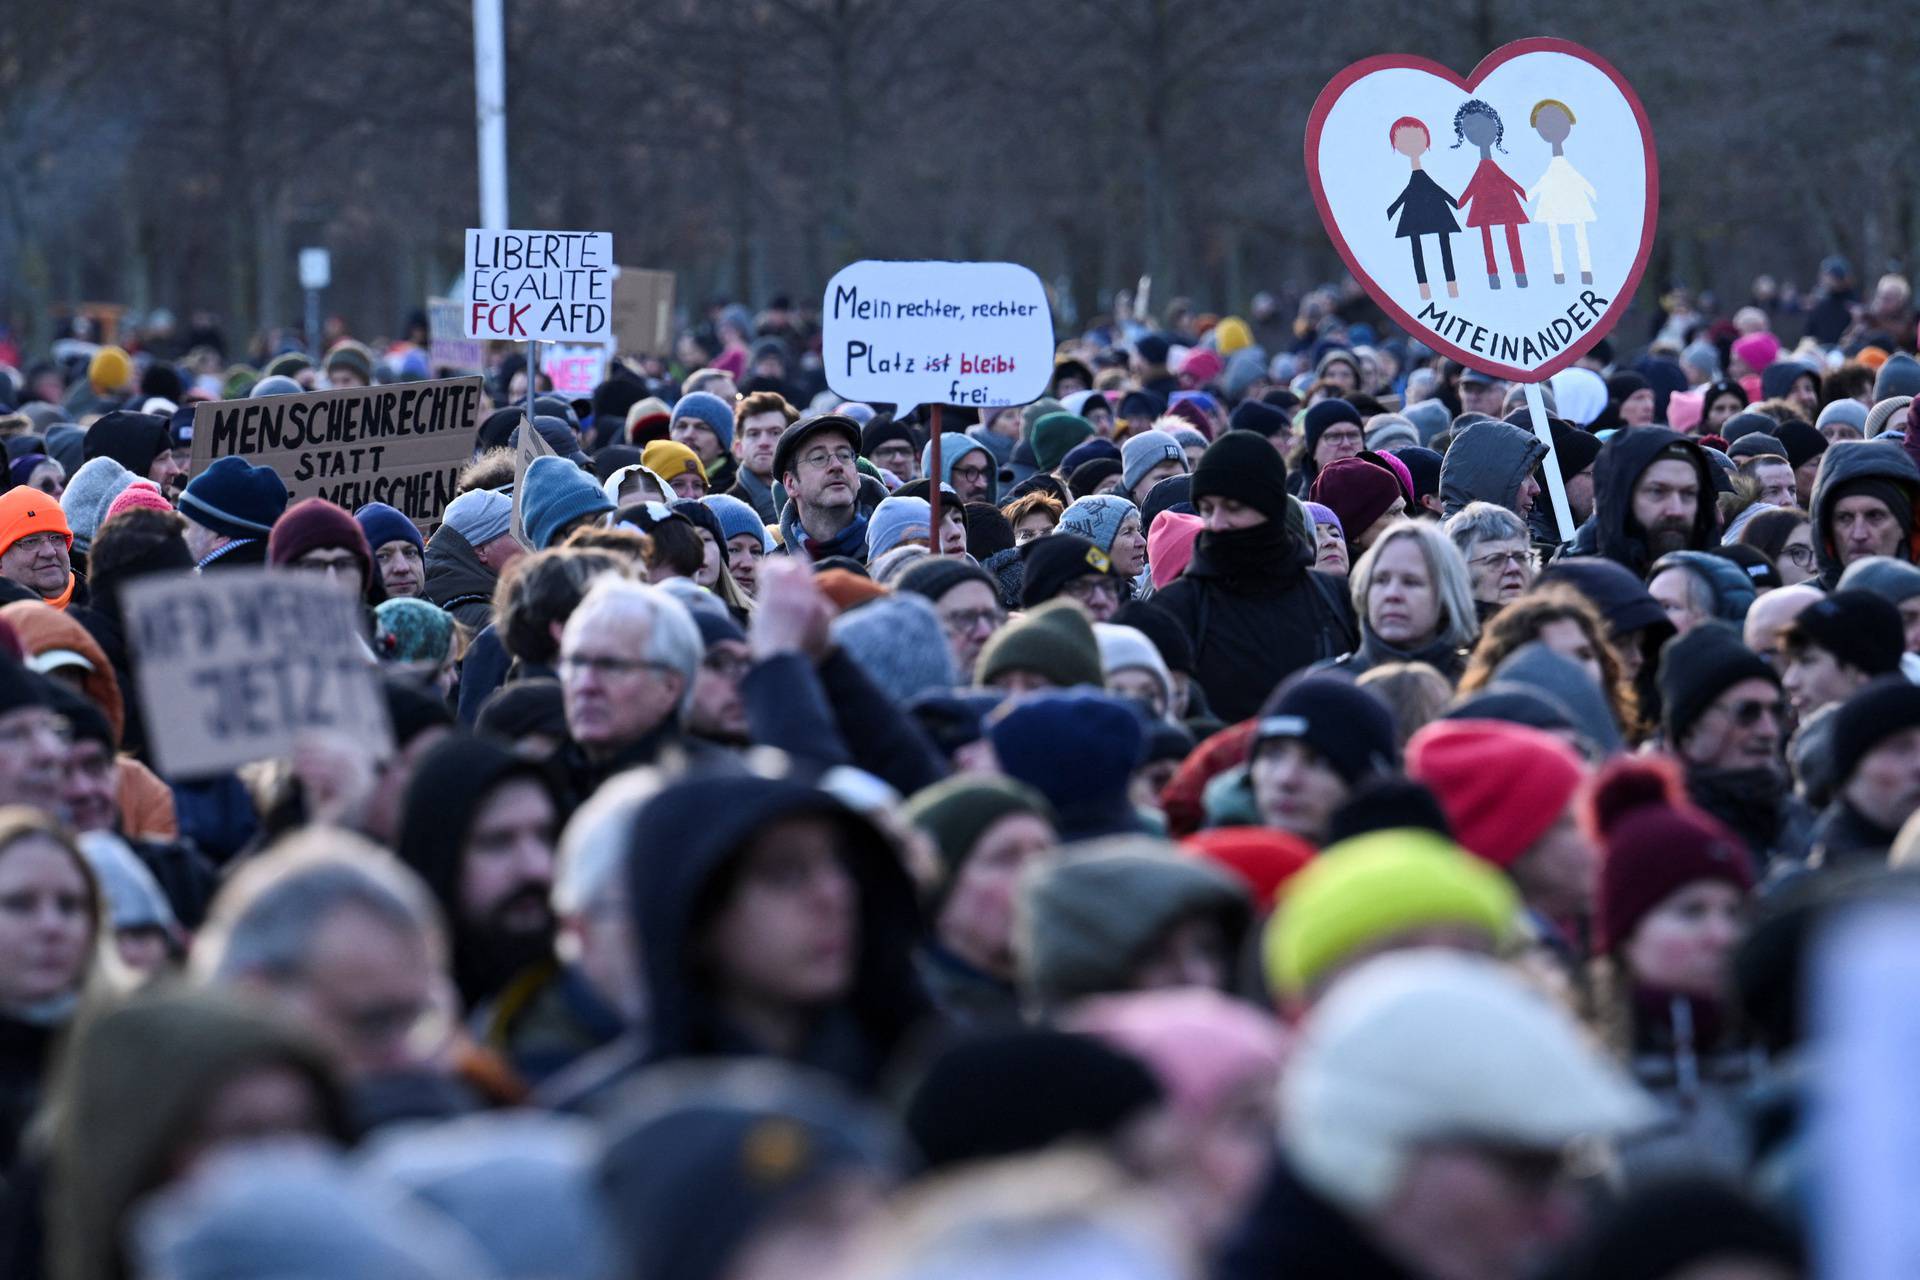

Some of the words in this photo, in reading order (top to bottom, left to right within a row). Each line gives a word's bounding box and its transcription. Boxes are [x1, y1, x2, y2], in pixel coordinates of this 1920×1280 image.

[475, 232, 599, 270] LIBERTÉ
[472, 302, 531, 336] FCK
[540, 302, 605, 333] AFD
[834, 285, 891, 320] Mein
[897, 299, 964, 321] rechter,
[972, 300, 1038, 317] rechter
[1417, 290, 1609, 365] MITEINANDER
[847, 340, 915, 377] Platz
[924, 354, 952, 372] ist
[960, 352, 1015, 374] bleibt
[211, 385, 477, 458] MENSCHENRECHTE
[294, 446, 385, 481] STATT
